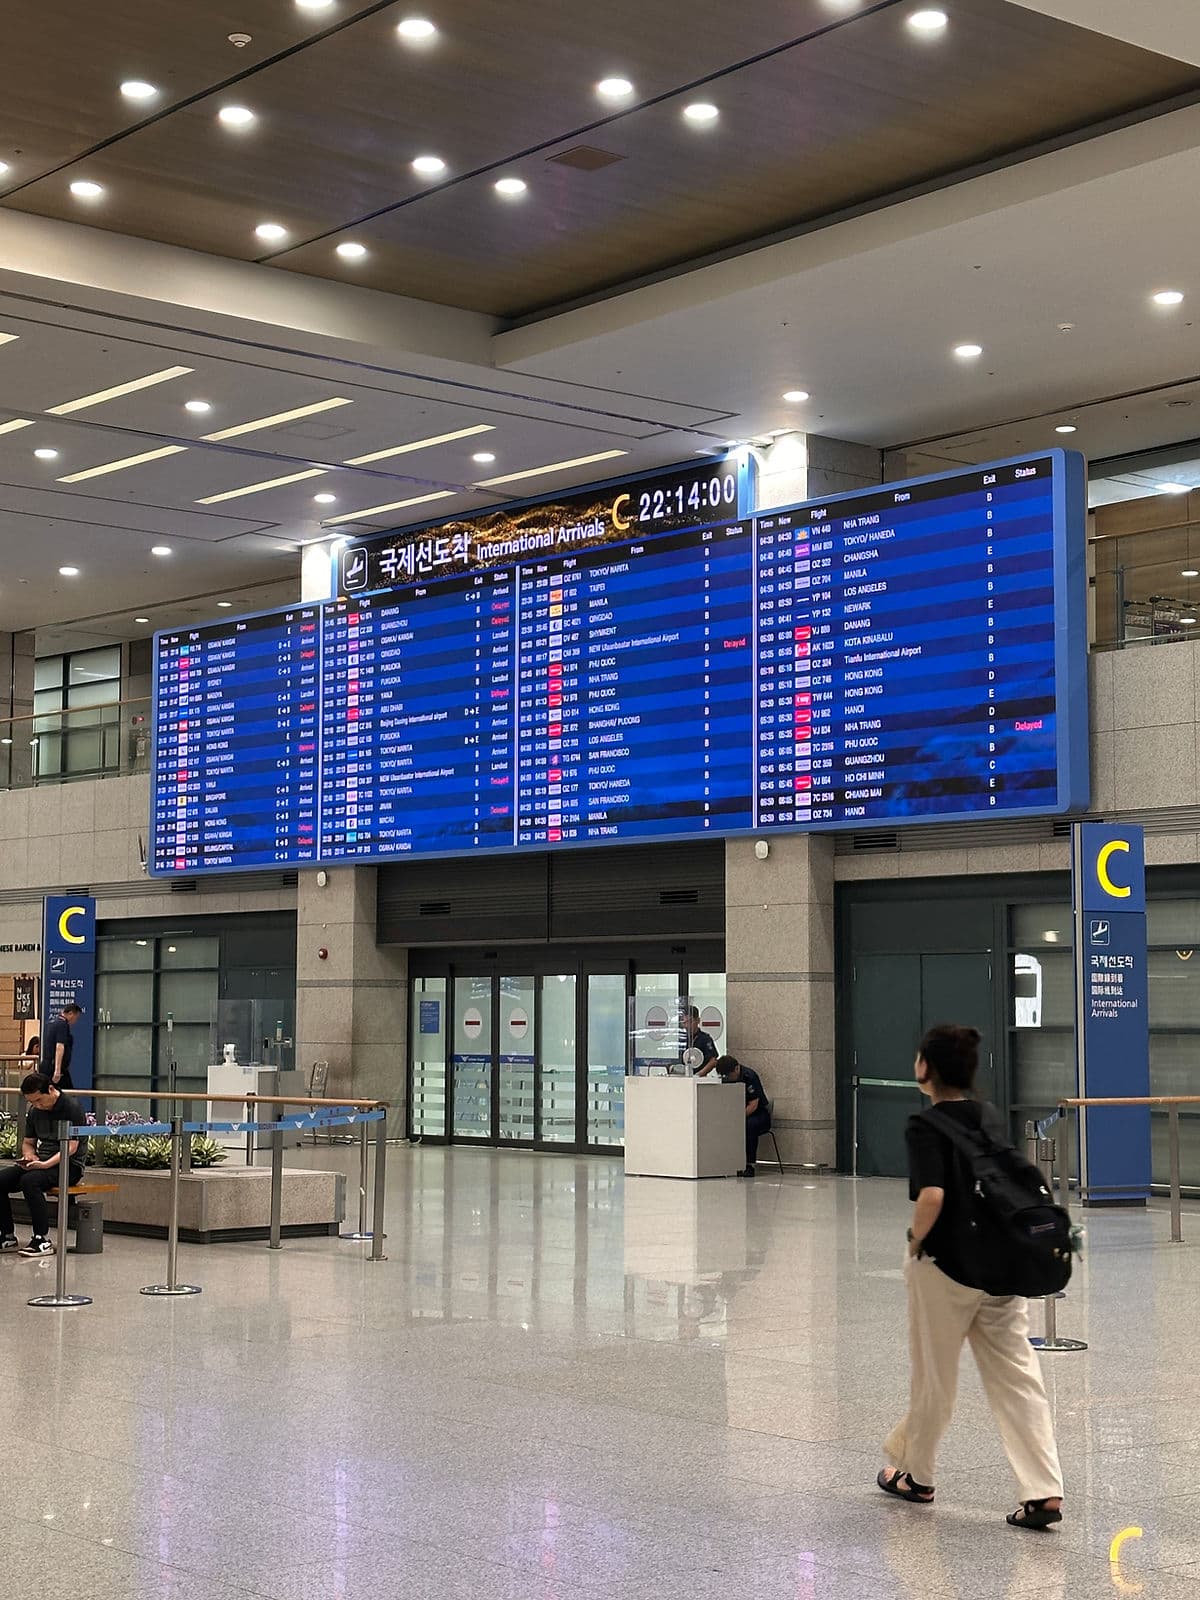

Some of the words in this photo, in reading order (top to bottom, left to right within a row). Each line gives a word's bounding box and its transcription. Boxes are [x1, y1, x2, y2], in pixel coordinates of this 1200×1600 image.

[611, 493, 631, 531] C
[639, 473, 735, 522] 22:14:00
[759, 520, 773, 529] Time
[810, 508, 826, 519] Flight
[894, 493, 910, 502] From
[983, 474, 996, 484] Exit
[1014, 467, 1036, 478] Status
[843, 519, 857, 529] NHA
[857, 514, 879, 526] TRANG
[986, 492, 992, 501] B
[476, 532, 554, 561] International
[559, 519, 604, 546] Arrivals
[843, 533, 868, 545] TOKYO/
[869, 529, 895, 541] HANEDA
[987, 510, 992, 519] B
[379, 532, 471, 579] 국제선도착
[811, 559, 820, 568] OZ
[843, 549, 878, 563] CHANGSHA
[987, 528, 992, 537] B
[811, 576, 821, 585] OZ
[844, 568, 867, 579] MANILA
[987, 546, 992, 555] E
[812, 592, 820, 601] YP
[844, 586, 856, 596] LOS
[857, 581, 887, 594] ANGELES
[987, 563, 993, 572] B
[811, 609, 820, 618] YP
[844, 601, 871, 613] NEWARK
[987, 581, 993, 590] B
[811, 626, 819, 635] VJ
[844, 618, 870, 630] DANANG
[988, 599, 993, 608] E
[844, 637, 861, 647] KOTA
[862, 632, 893, 644] KINABALU
[988, 617, 993, 626] B
[812, 659, 821, 668] OZ
[863, 648, 900, 661] International
[900, 646, 921, 657] Airport
[988, 635, 994, 644] B
[812, 676, 821, 685] OZ
[844, 670, 863, 680] HONG
[864, 668, 882, 678] KONG
[988, 653, 994, 662] B
[812, 693, 822, 701] TW
[844, 687, 863, 697] HONG
[864, 685, 883, 695] KONG
[988, 671, 994, 680] D
[811, 710, 820, 718] VJ
[844, 704, 864, 714] HANOI
[989, 688, 994, 697] E
[812, 726, 820, 735] VJ
[844, 722, 858, 731] NHA
[859, 719, 881, 730] TRANG
[989, 706, 995, 716] D
[812, 743, 820, 751] 7C
[844, 739, 858, 748] PHU
[859, 736, 878, 747] QUOC
[989, 724, 995, 733] B
[1015, 719, 1042, 731] Delayed
[812, 759, 821, 769] OZ
[844, 753, 884, 765] GUANGZHOU
[989, 742, 995, 751] B
[812, 776, 820, 785] VJ
[844, 773, 855, 782] HO
[855, 772, 867, 781] CHI
[868, 771, 884, 780] MINH
[989, 760, 995, 769] C
[812, 793, 821, 802] 7C
[844, 789, 869, 799] CHIANG
[870, 788, 882, 797] MAI
[989, 778, 995, 787] E
[812, 809, 822, 819] OZ
[845, 806, 865, 816] HANOI
[990, 796, 995, 805] B
[1096, 839, 1131, 898] C
[58, 906, 86, 944] C
[1091, 955, 1134, 968] 국제선도착
[1091, 999, 1138, 1008] International
[1091, 1008, 1119, 1018] Arrivals
